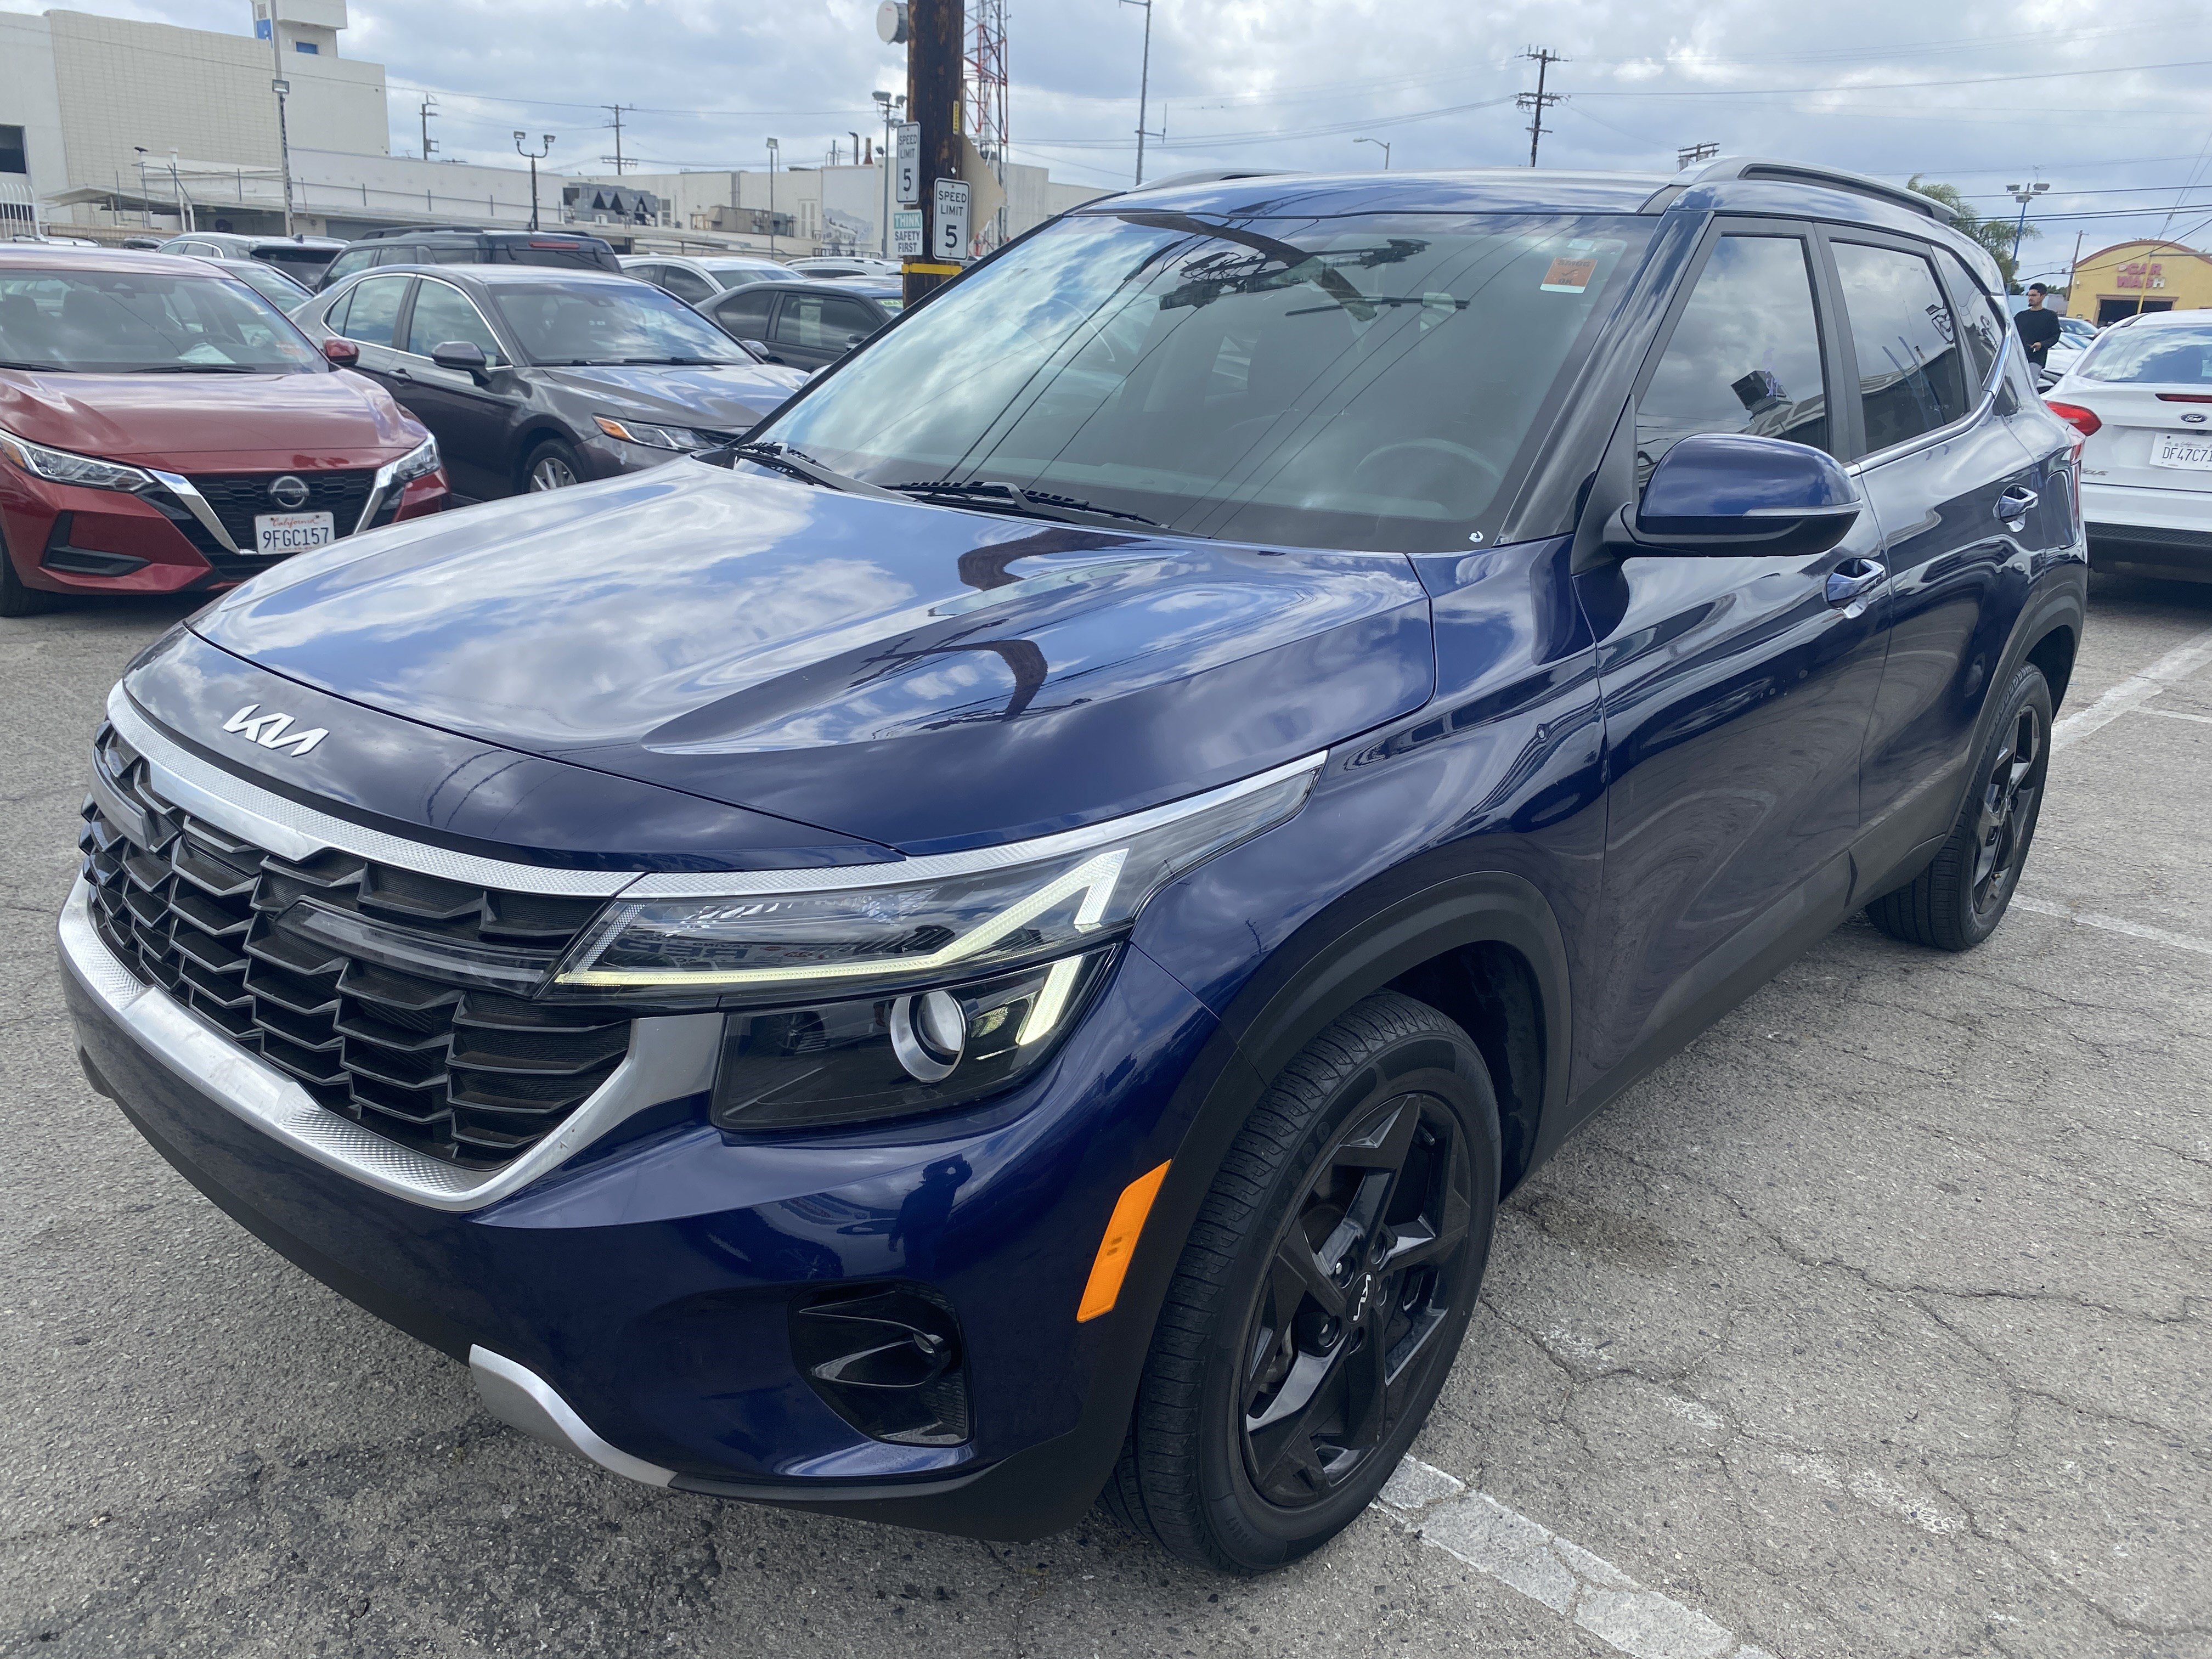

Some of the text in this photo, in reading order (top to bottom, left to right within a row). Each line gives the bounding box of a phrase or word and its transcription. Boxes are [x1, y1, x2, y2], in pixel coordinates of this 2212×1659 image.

[899, 134, 917, 145] SPEED
[900, 148, 915, 159] LIMIT
[903, 168, 911, 191] 5
[939, 190, 967, 203] SPEED
[941, 204, 963, 216] LIMIT
[894, 214, 921, 227] THINK
[895, 230, 920, 241] SAFETY
[945, 224, 957, 248] 5
[898, 242, 917, 252] FIRST
[2128, 263, 2162, 275] CAR
[2117, 275, 2165, 288] WASH
[2162, 447, 2212, 462] DF47C71
[273, 517, 319, 528] California
[263, 527, 329, 549] 9FGC157
[223, 704, 330, 757] KIA
[1352, 1274, 1372, 1321] KIA
